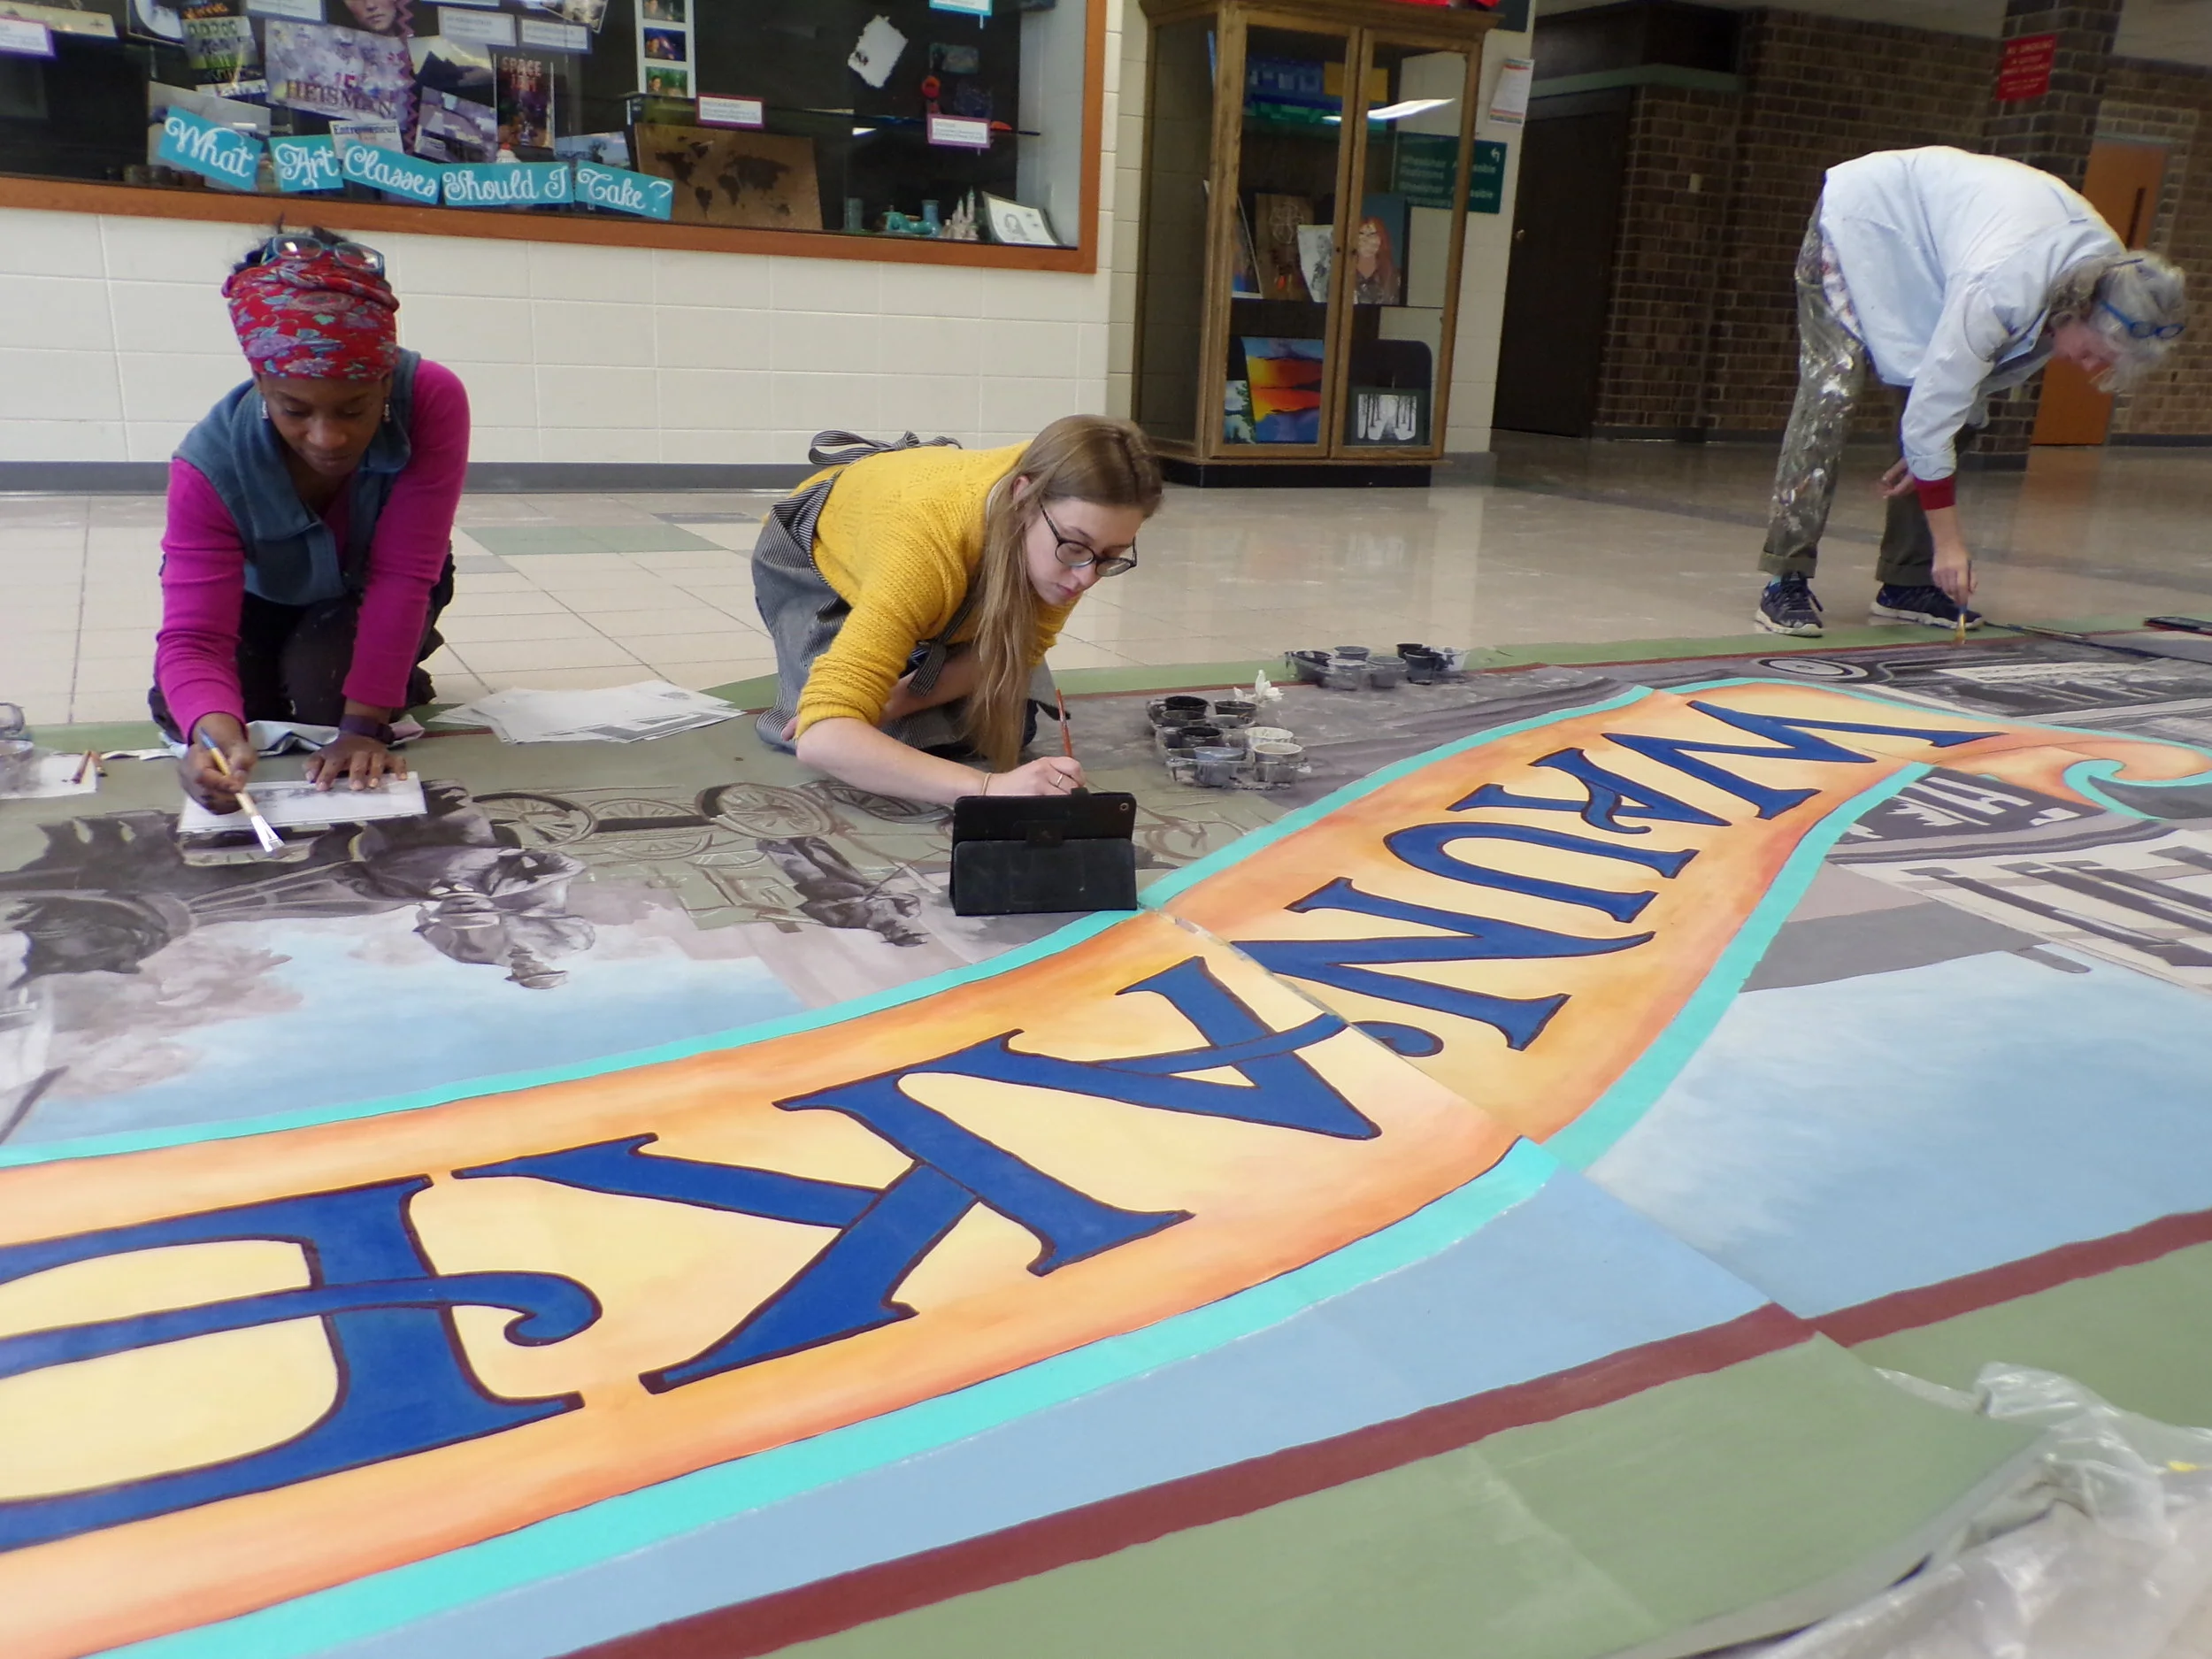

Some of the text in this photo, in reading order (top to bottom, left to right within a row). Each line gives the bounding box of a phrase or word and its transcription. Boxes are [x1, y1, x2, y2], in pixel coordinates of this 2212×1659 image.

[501, 56, 541, 77] SPACE
[286, 80, 398, 119] HEISMAN
[165, 116, 254, 178] What
[274, 143, 341, 188] Art
[344, 144, 437, 197] Classes
[442, 169, 540, 201] Should
[545, 165, 569, 200] I
